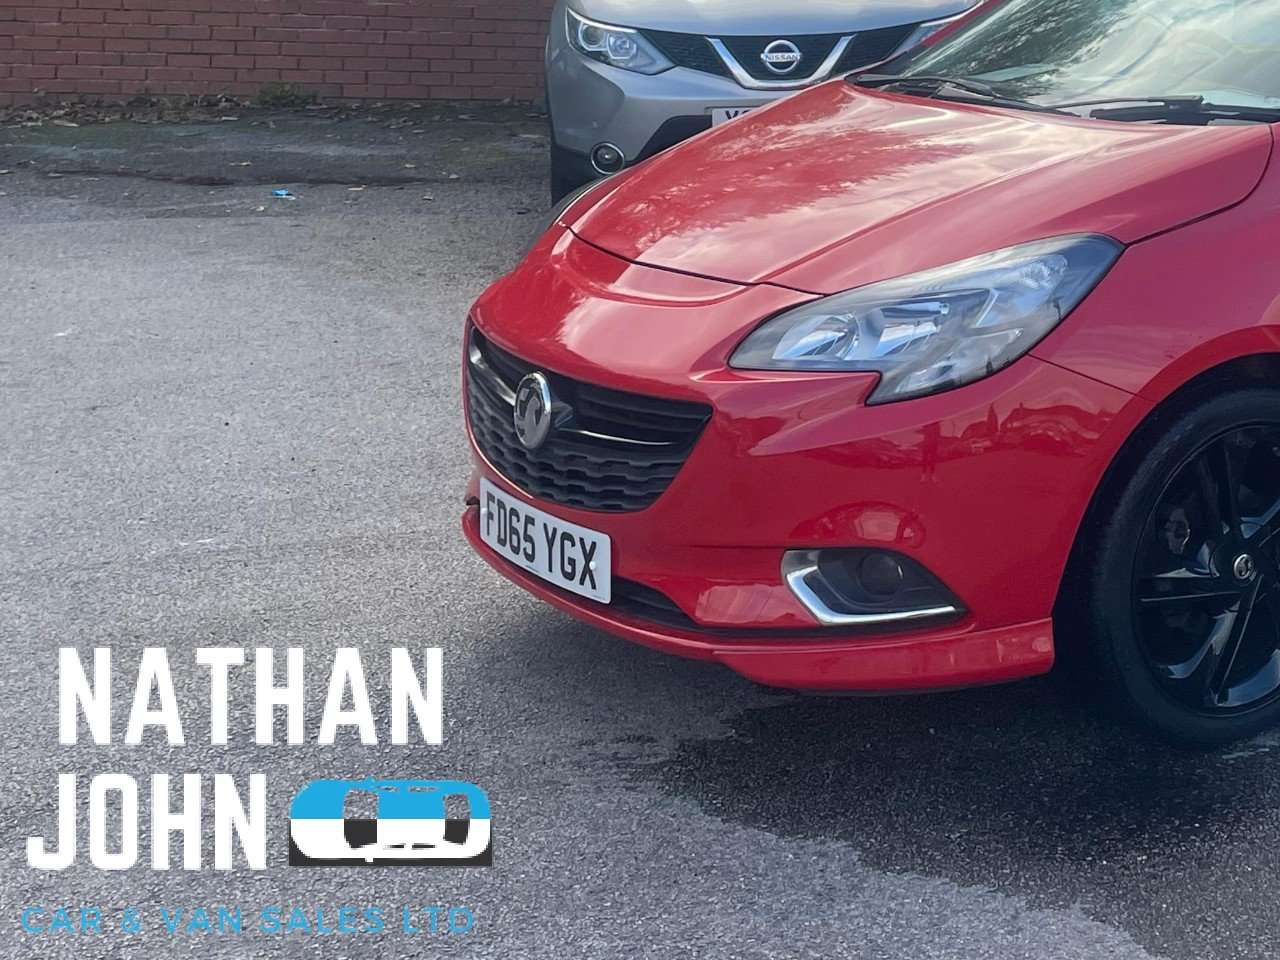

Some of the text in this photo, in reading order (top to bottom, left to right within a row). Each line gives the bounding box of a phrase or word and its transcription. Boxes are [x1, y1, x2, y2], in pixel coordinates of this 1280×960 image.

[767, 53, 798, 61] NISSAN
[485, 490, 597, 590] FD65 YGX
